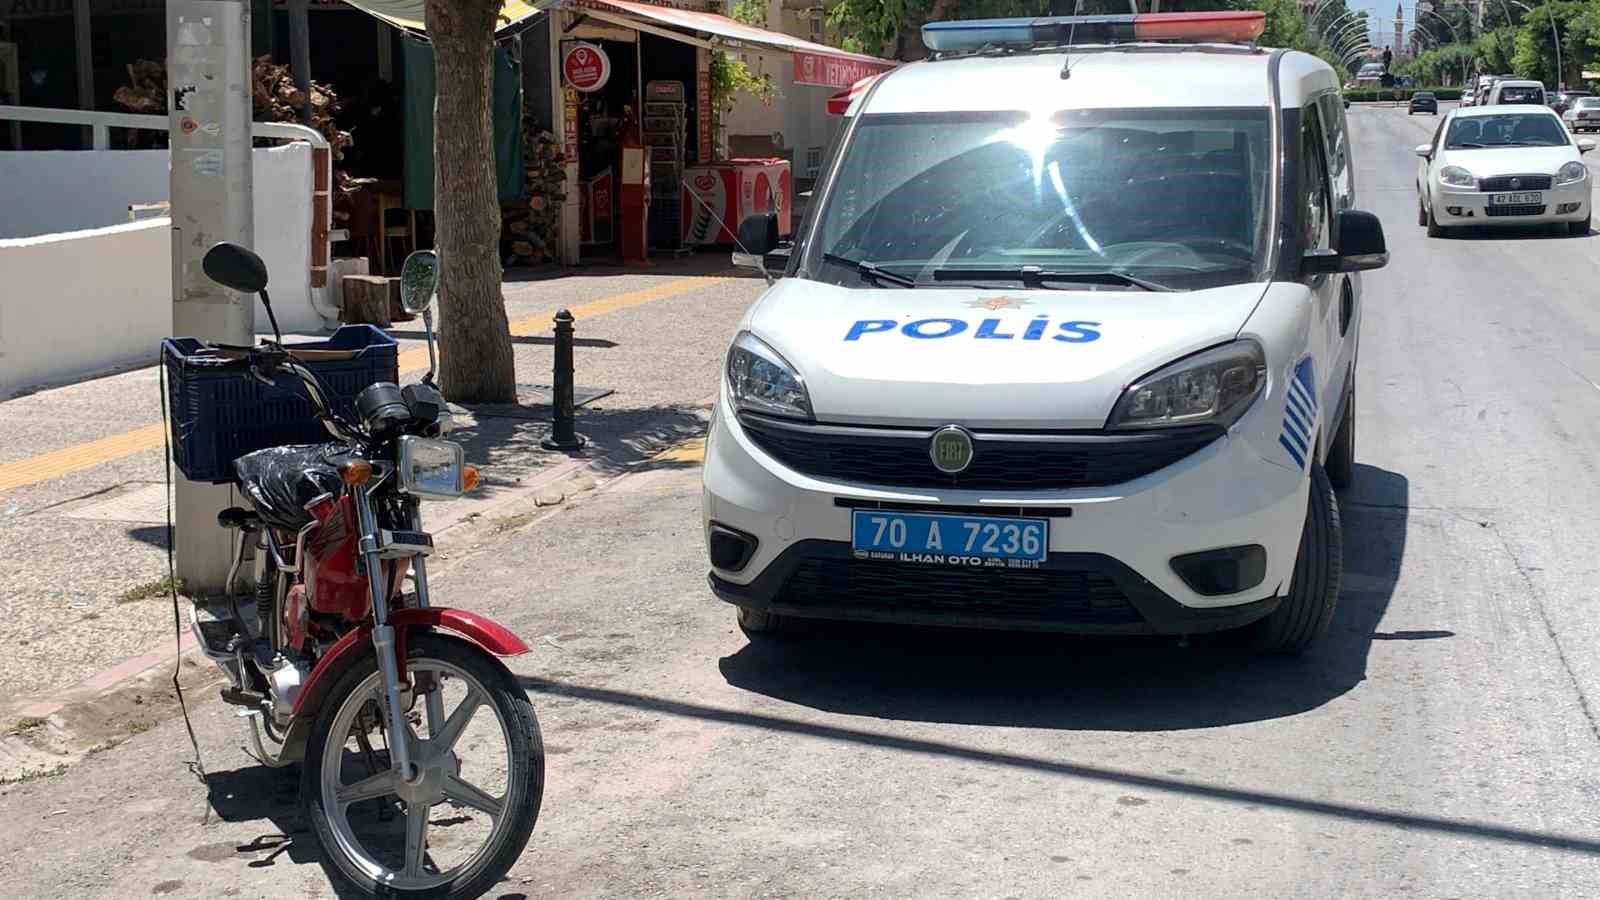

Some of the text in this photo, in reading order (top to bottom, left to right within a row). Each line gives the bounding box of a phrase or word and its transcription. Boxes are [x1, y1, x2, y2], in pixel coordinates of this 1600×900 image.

[843, 314, 1103, 343] POLİS
[940, 440, 963, 461] FIAT
[871, 517, 1041, 555] 70 A 7236
[948, 556, 982, 566] OTO
